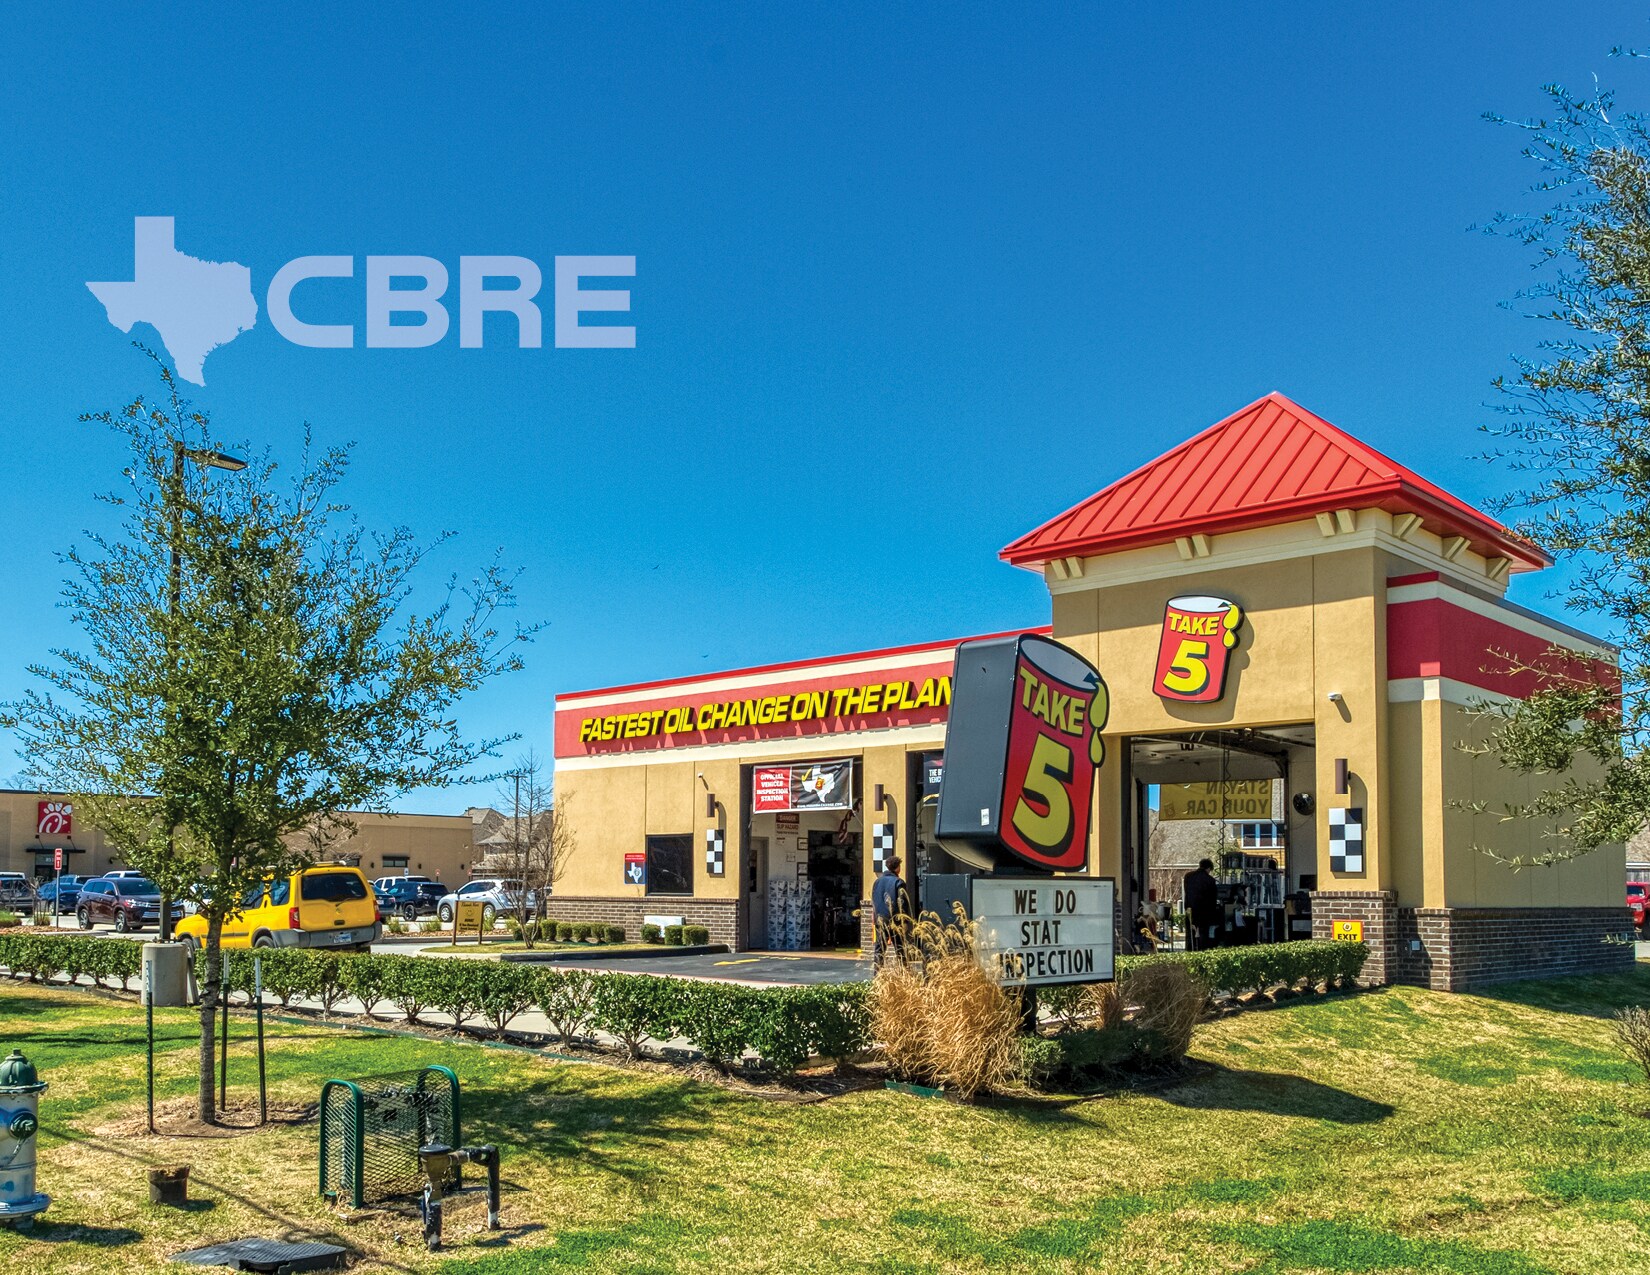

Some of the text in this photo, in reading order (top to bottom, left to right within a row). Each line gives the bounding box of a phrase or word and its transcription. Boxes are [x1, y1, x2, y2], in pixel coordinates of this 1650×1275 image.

[1168, 612, 1219, 636] TAKE
[1162, 639, 1210, 696] 5
[580, 676, 952, 742] FASTEST OIL CHANGE ON THE PLAN
[1019, 666, 1086, 737] TAKE
[1012, 733, 1075, 858] 5
[1015, 890, 1076, 914] WE DO
[1021, 920, 1061, 946] STAT
